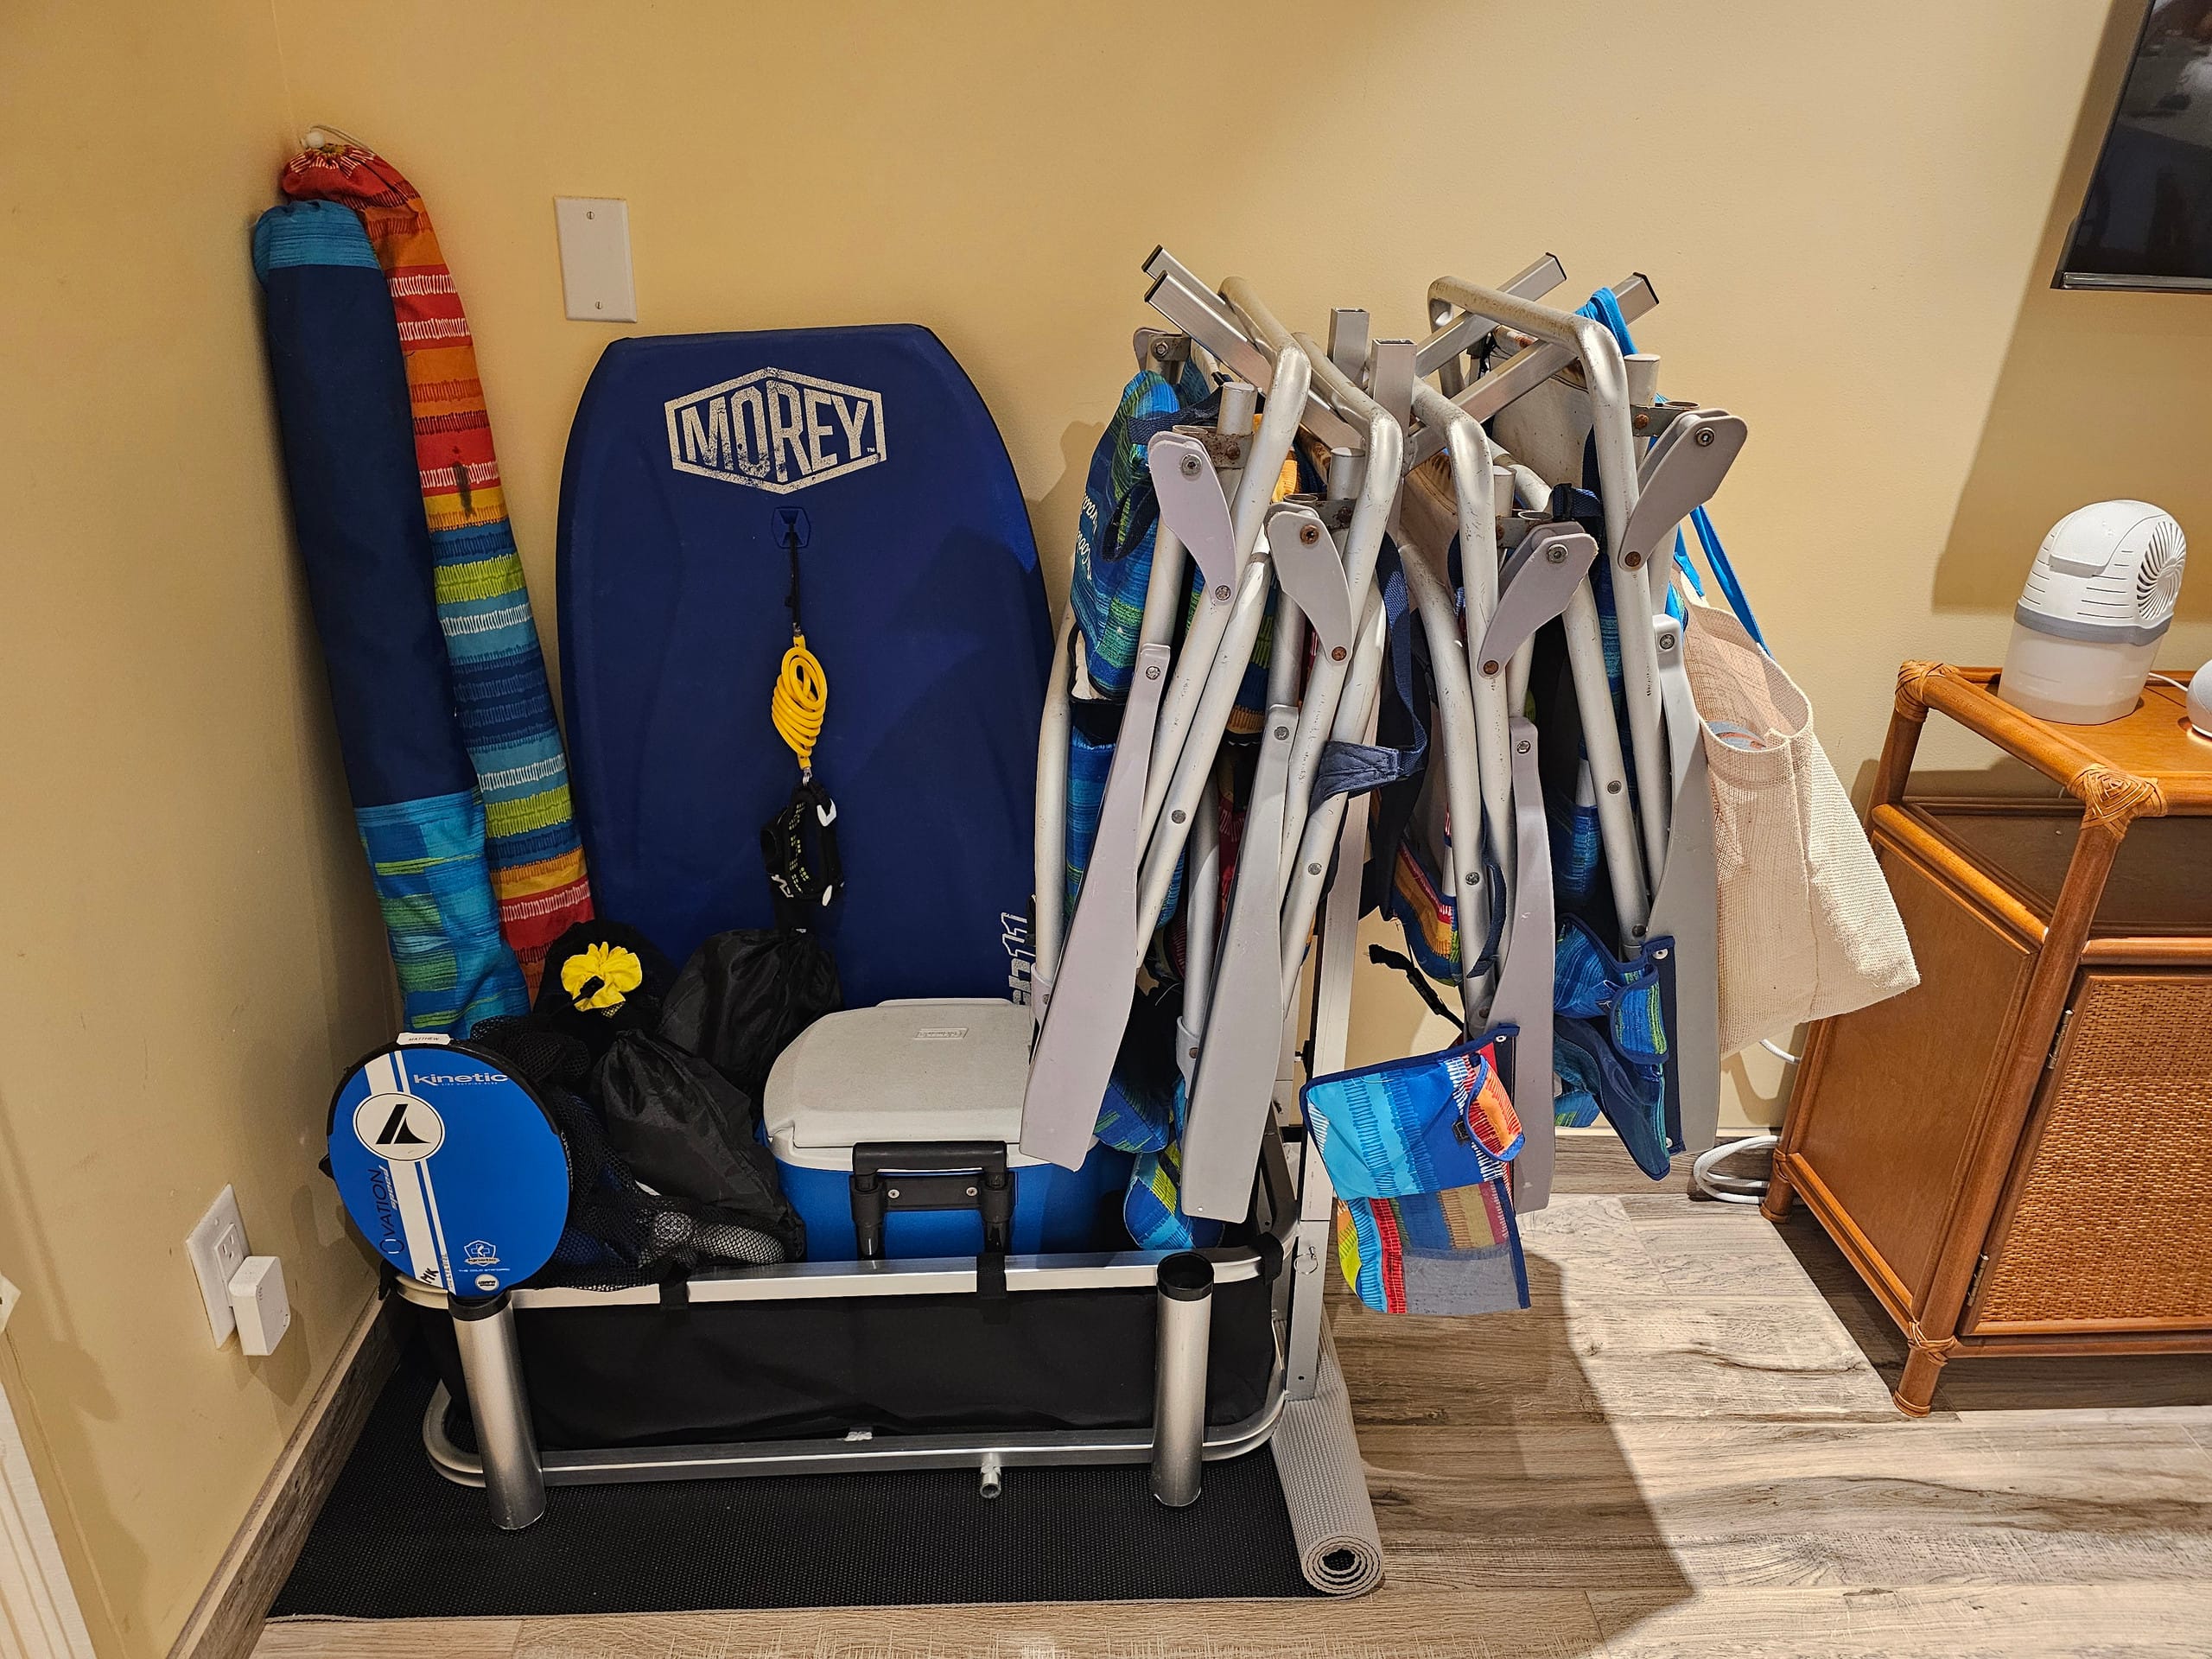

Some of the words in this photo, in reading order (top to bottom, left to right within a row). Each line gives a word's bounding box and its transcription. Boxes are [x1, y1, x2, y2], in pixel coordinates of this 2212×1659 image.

[681, 380, 868, 483] MOREY
[413, 1072, 509, 1087] kinetic
[378, 1164, 398, 1211] speed
[367, 1168, 405, 1255] OVATION
[420, 1267, 439, 1284] MK
